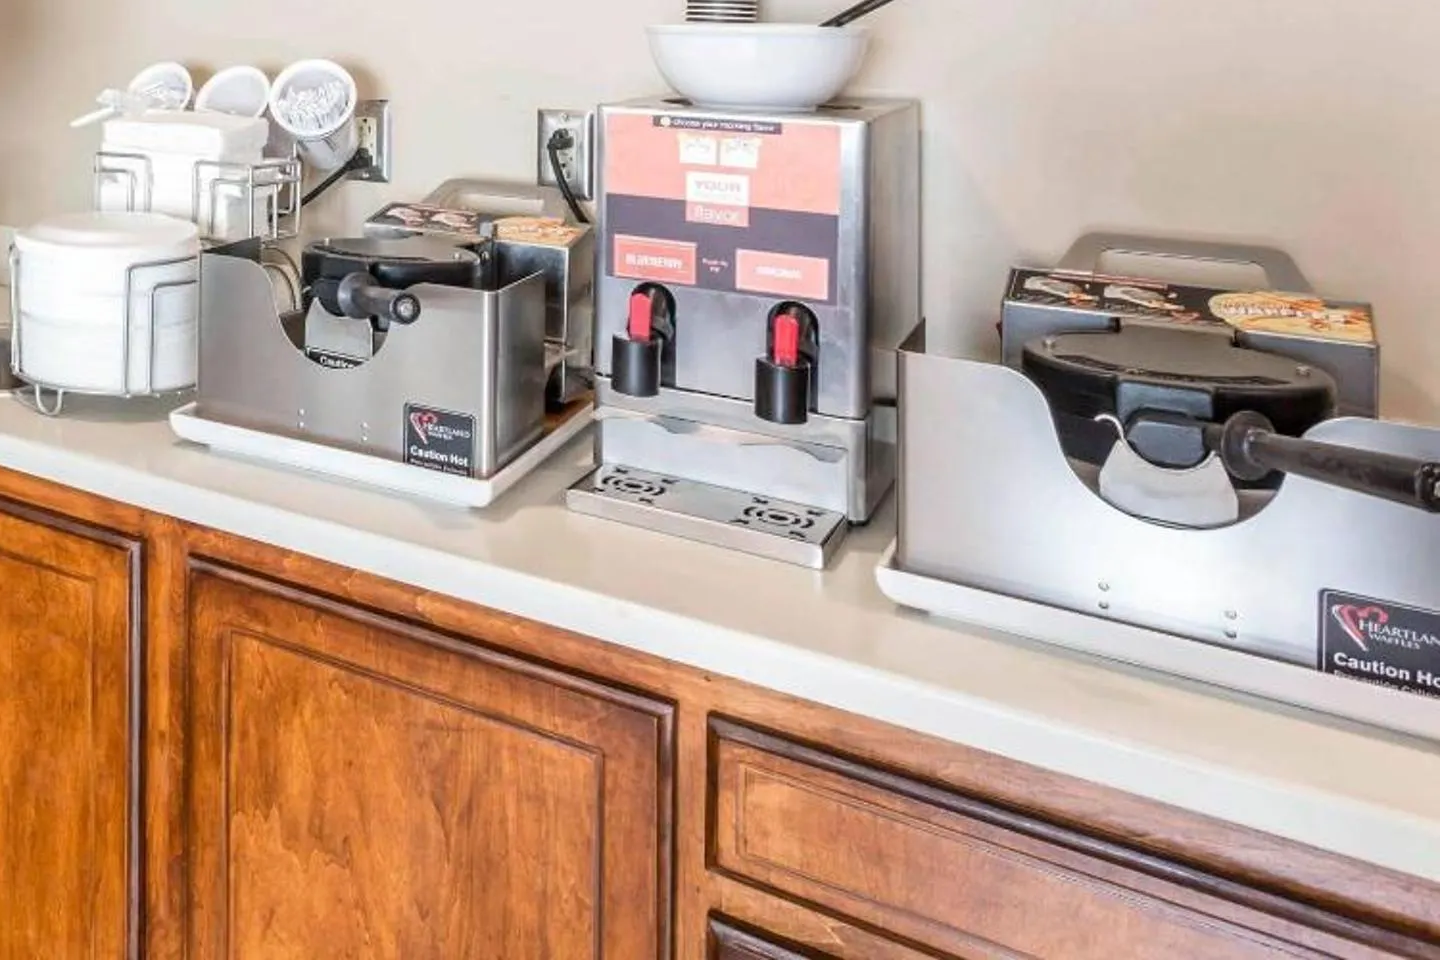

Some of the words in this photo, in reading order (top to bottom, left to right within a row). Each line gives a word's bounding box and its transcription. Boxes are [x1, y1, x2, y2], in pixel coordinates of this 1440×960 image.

[410, 444, 448, 462] Caution
[450, 453, 468, 466] Hot
[1359, 618, 1440, 646] HEARTLAN
[1369, 632, 1421, 650] WAFFLES
[1333, 652, 1410, 681] Caution
[1416, 670, 1440, 689] Ho
